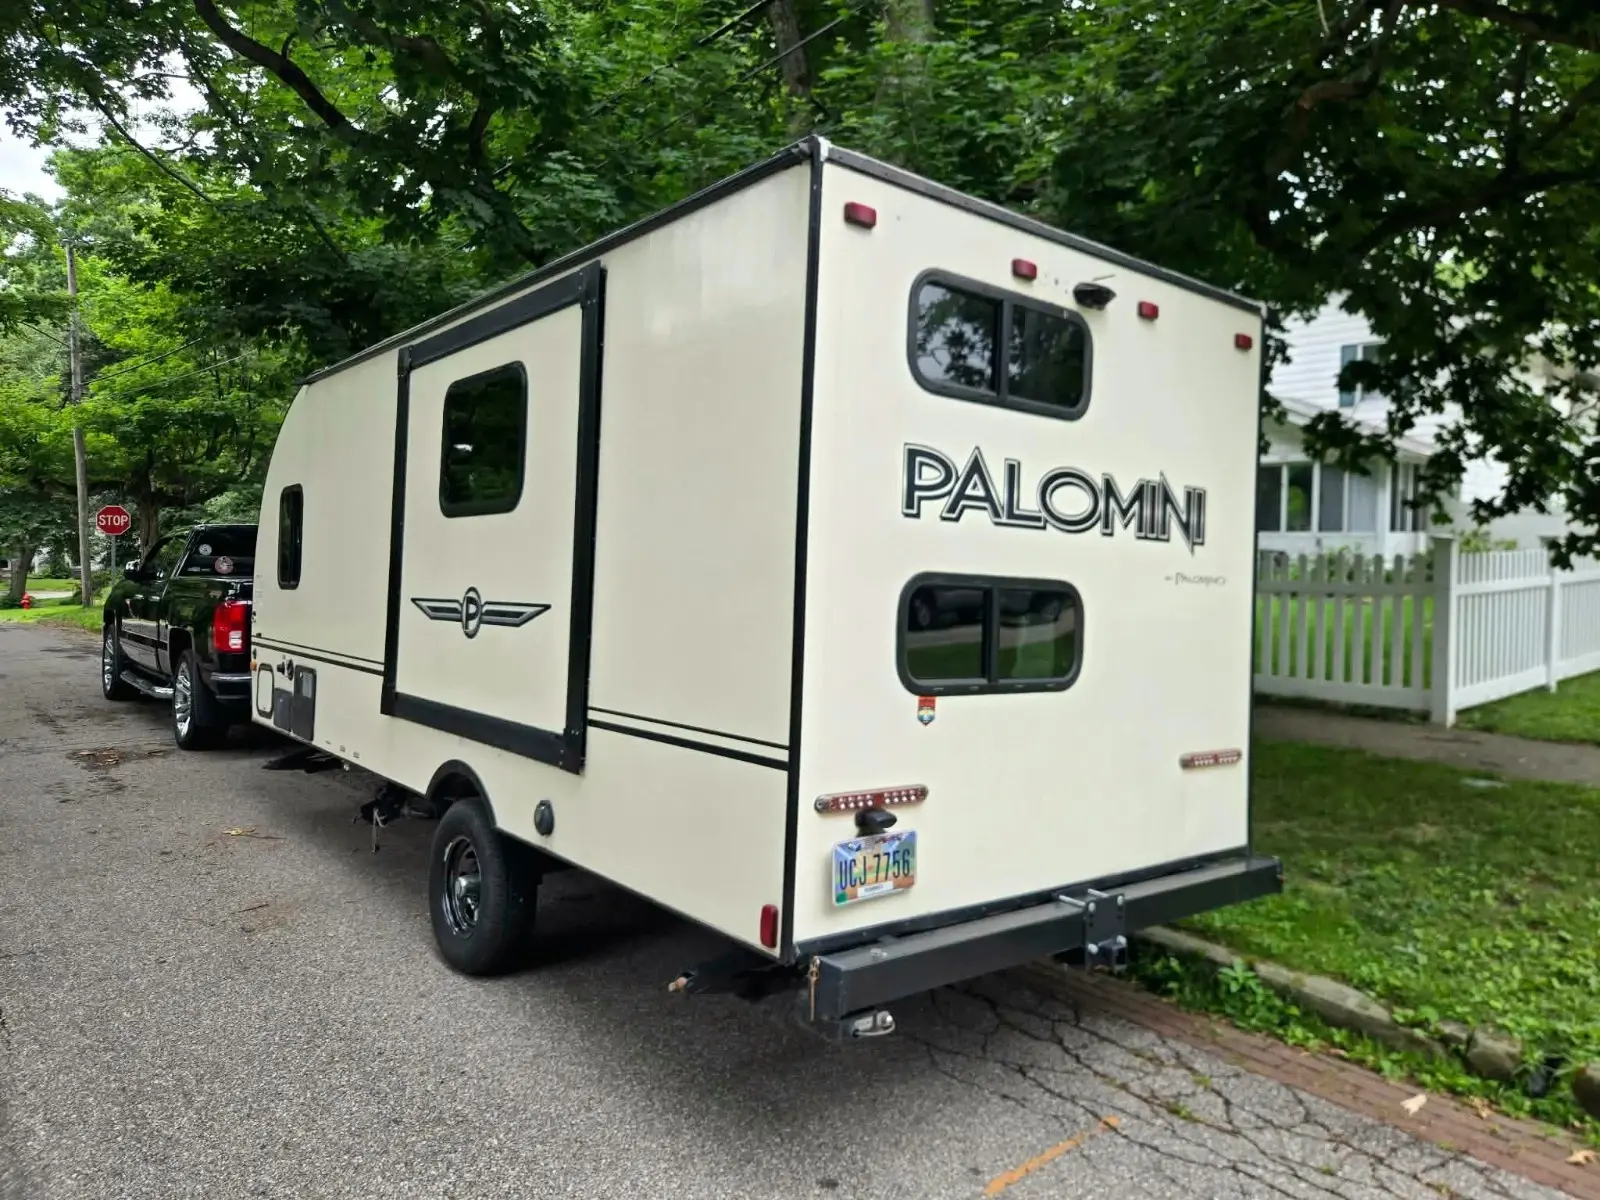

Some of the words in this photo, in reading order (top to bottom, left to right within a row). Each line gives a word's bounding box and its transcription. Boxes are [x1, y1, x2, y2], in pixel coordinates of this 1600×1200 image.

[98, 514, 129, 526] STOP
[839, 855, 867, 890] UCJ
[873, 848, 911, 883] 7756
